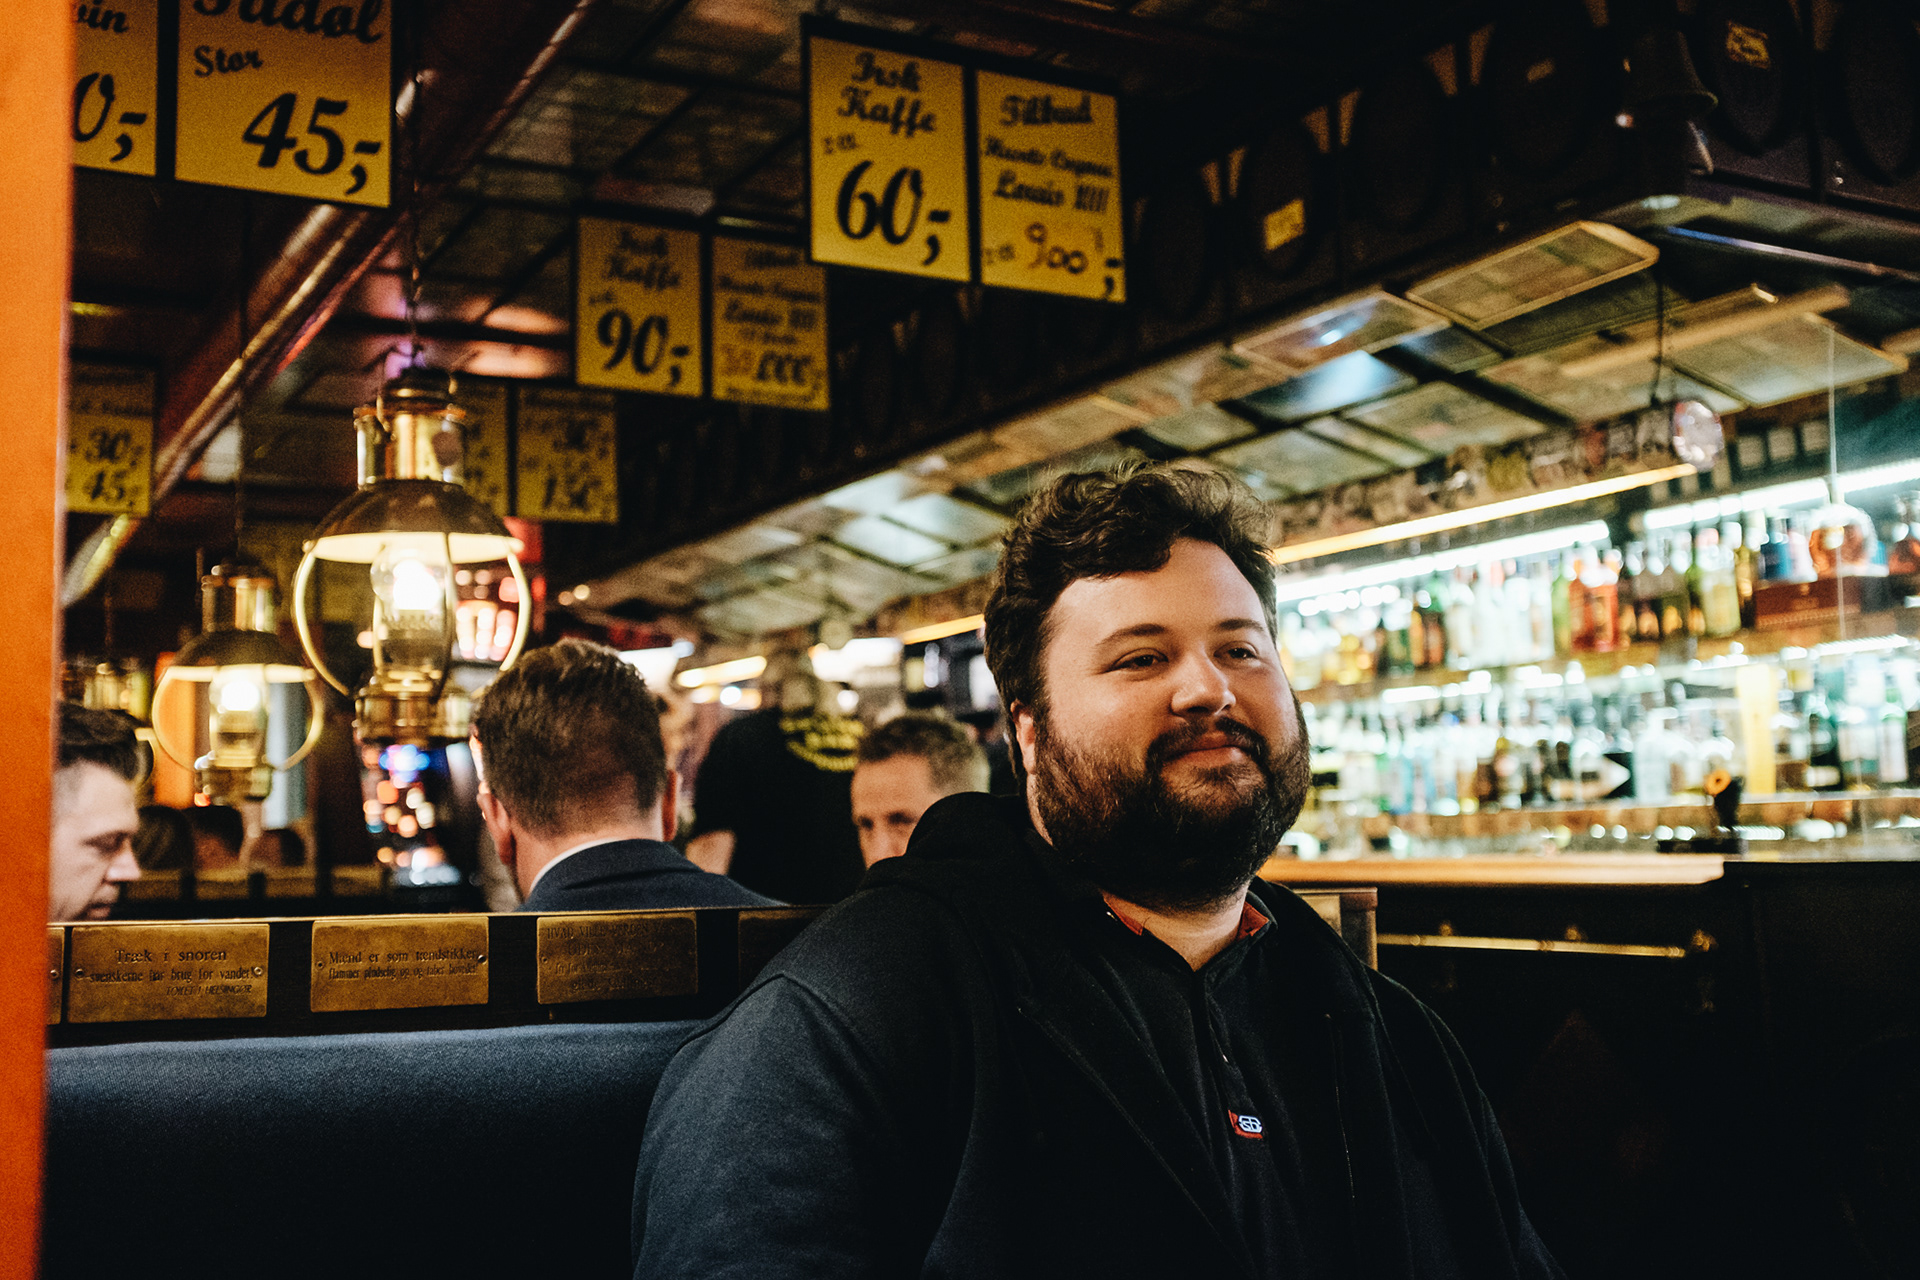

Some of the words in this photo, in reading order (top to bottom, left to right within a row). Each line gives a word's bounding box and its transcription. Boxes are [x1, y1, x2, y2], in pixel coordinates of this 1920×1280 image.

[194, 45, 263, 77] Stor
[837, 86, 937, 138] Kaffe
[243, 92, 382, 196] 45,-
[837, 160, 952, 266] 60,-
[597, 308, 691, 387] 90,-
[115, 949, 153, 964] Træk
[178, 949, 227, 963] snoren
[171, 967, 193, 983] brug
[198, 968, 214, 981] for
[329, 951, 362, 964] Mænd
[369, 951, 380, 963] er
[387, 951, 409, 963] som
